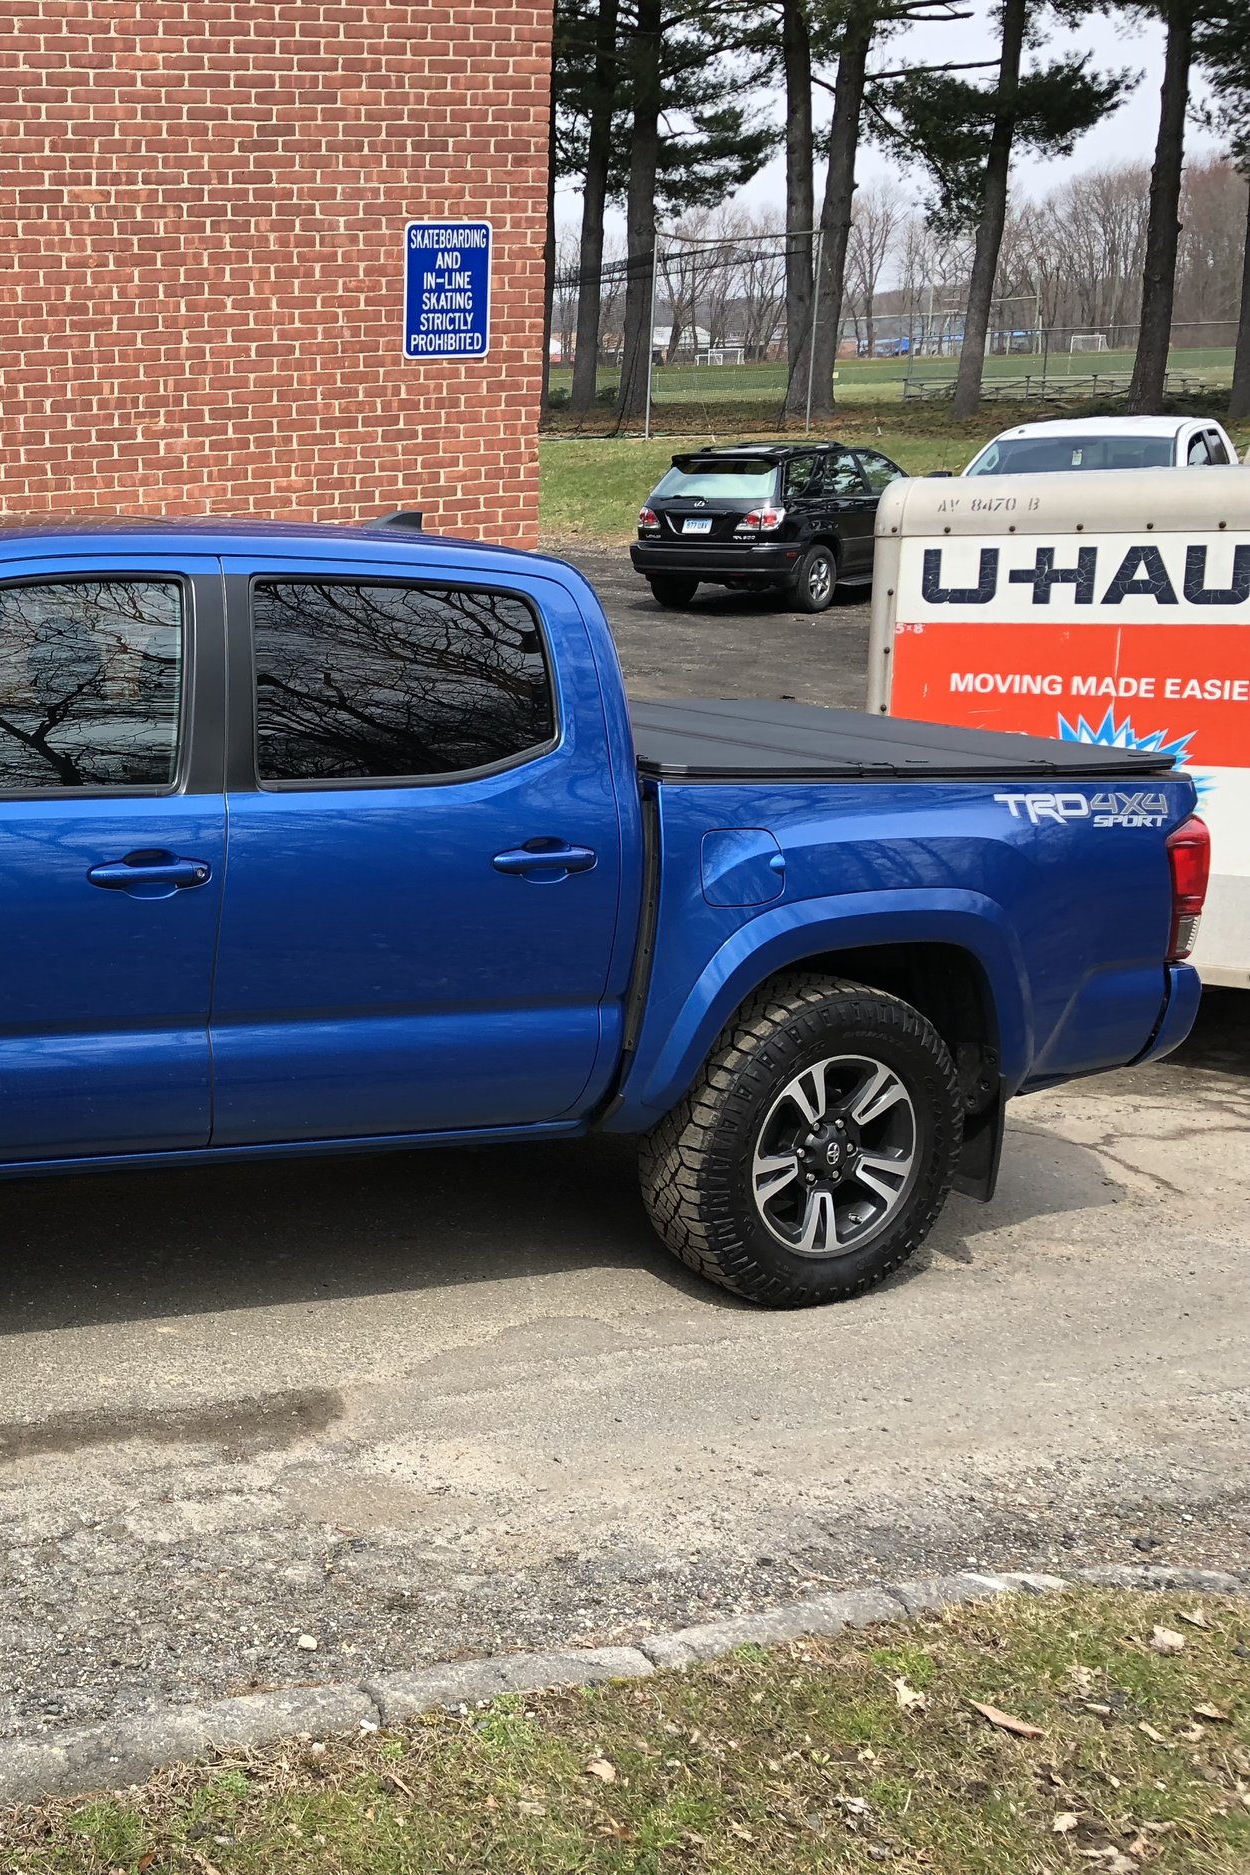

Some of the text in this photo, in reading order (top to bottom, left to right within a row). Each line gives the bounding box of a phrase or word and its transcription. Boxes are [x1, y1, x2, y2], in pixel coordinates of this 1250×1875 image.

[410, 229, 487, 249] SKATEBOARDING
[435, 252, 461, 269] AND
[423, 271, 472, 290] IN-LINE
[422, 292, 473, 310] SKATING
[419, 312, 474, 331] STRICTLY
[410, 333, 482, 352] PROHIBITED
[971, 497, 1017, 511] 8470
[950, 672, 1064, 696] MOVING
[1070, 675, 1155, 698] MADE
[993, 793, 1091, 826] TRD
[1093, 814, 1168, 828] SPORT
